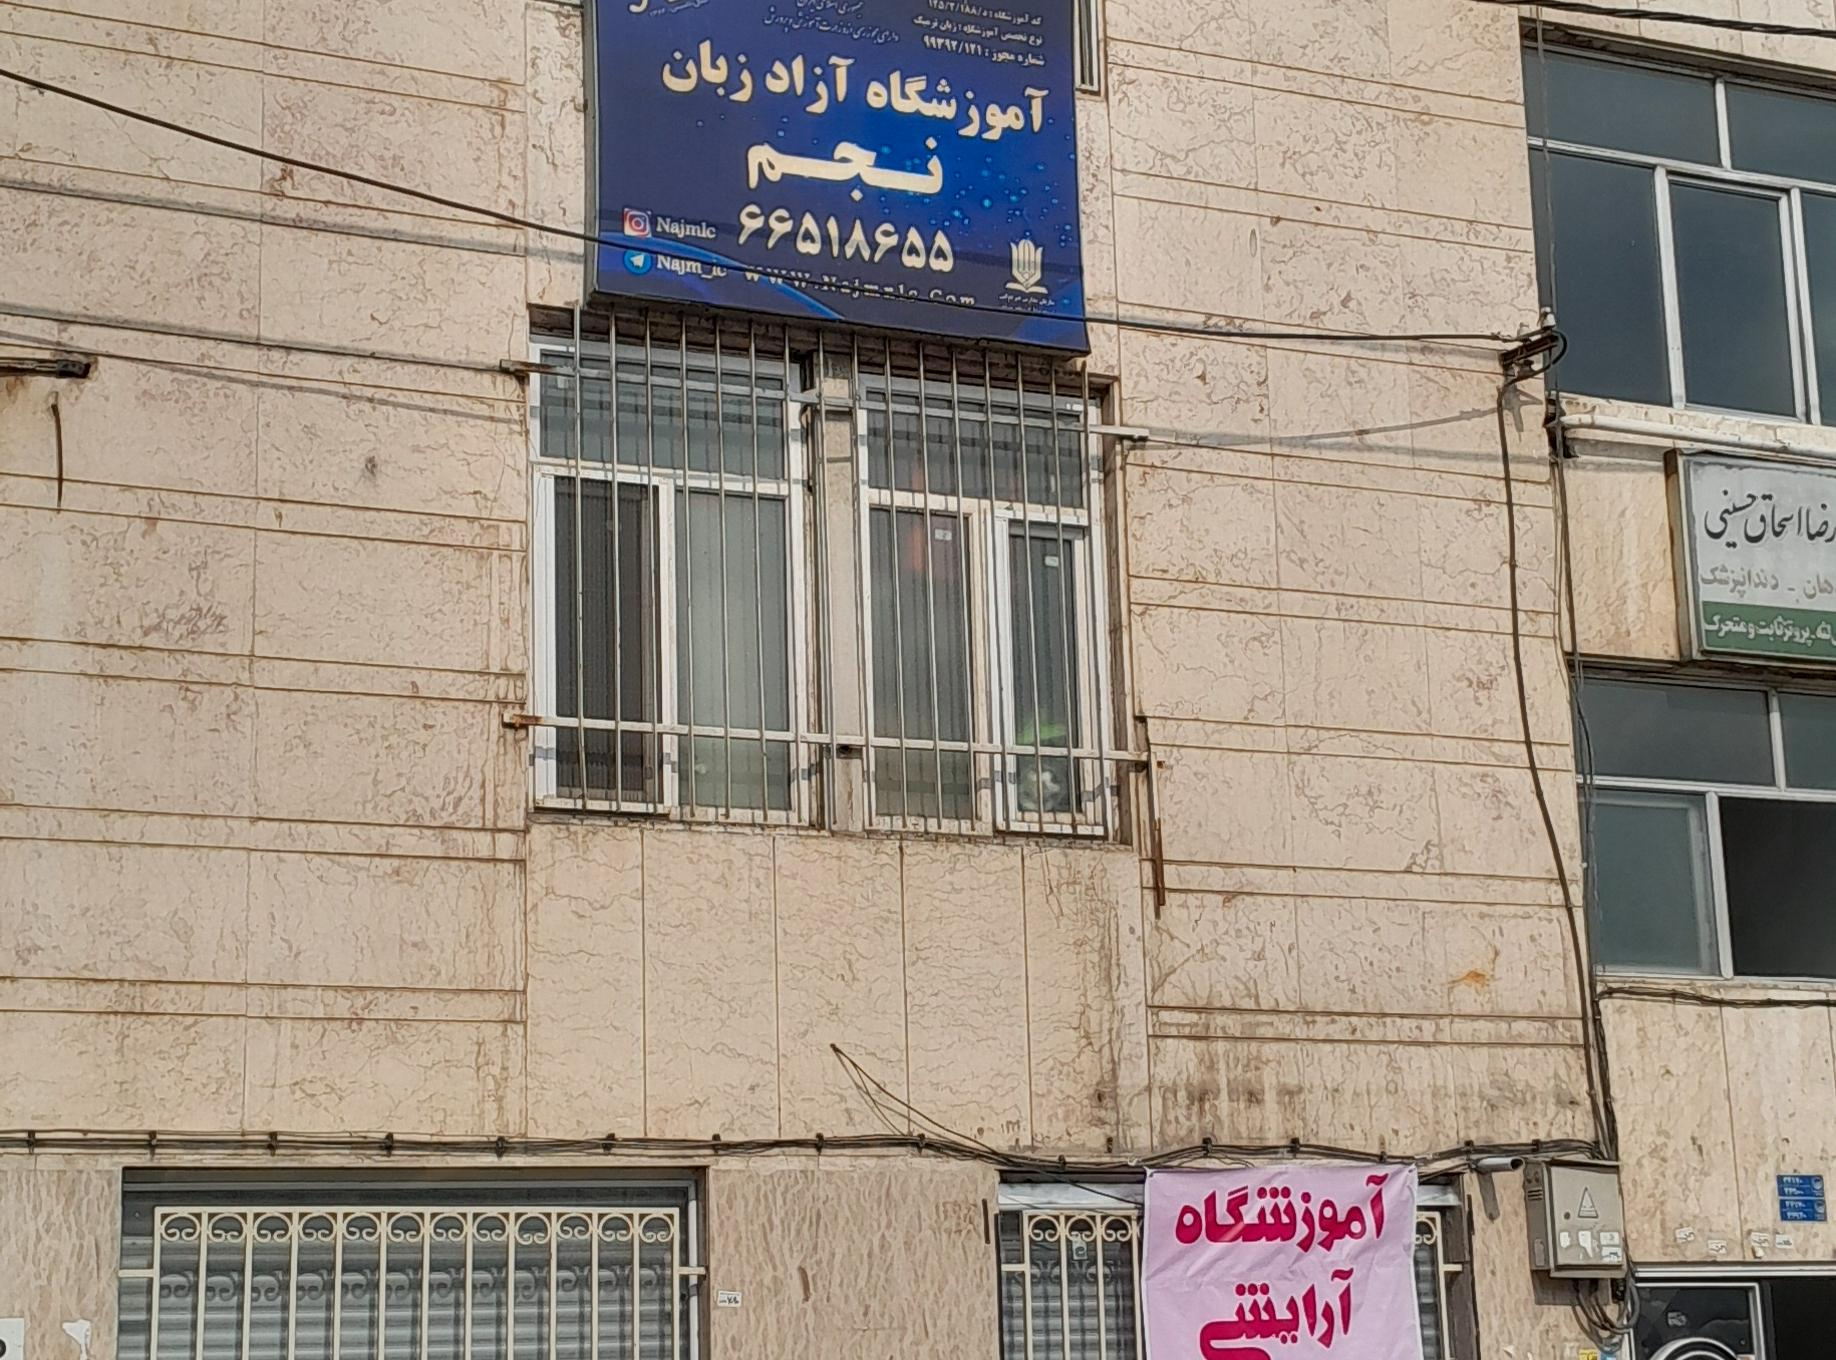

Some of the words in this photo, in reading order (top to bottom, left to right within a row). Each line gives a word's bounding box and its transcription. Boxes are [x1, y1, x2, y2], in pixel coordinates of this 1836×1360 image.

[661, 39, 754, 102] زبان
[765, 54, 855, 114] آزاد
[866, 70, 1050, 140] آموزشگاه
[745, 137, 943, 202] نجم
[656, 216, 717, 239] Najmlc
[737, 203, 954, 273] ۶۶۵۱۸۶۵۵
[1803, 572, 1836, 601] هان
[1175, 1172, 1390, 1253] آموزشگاه
